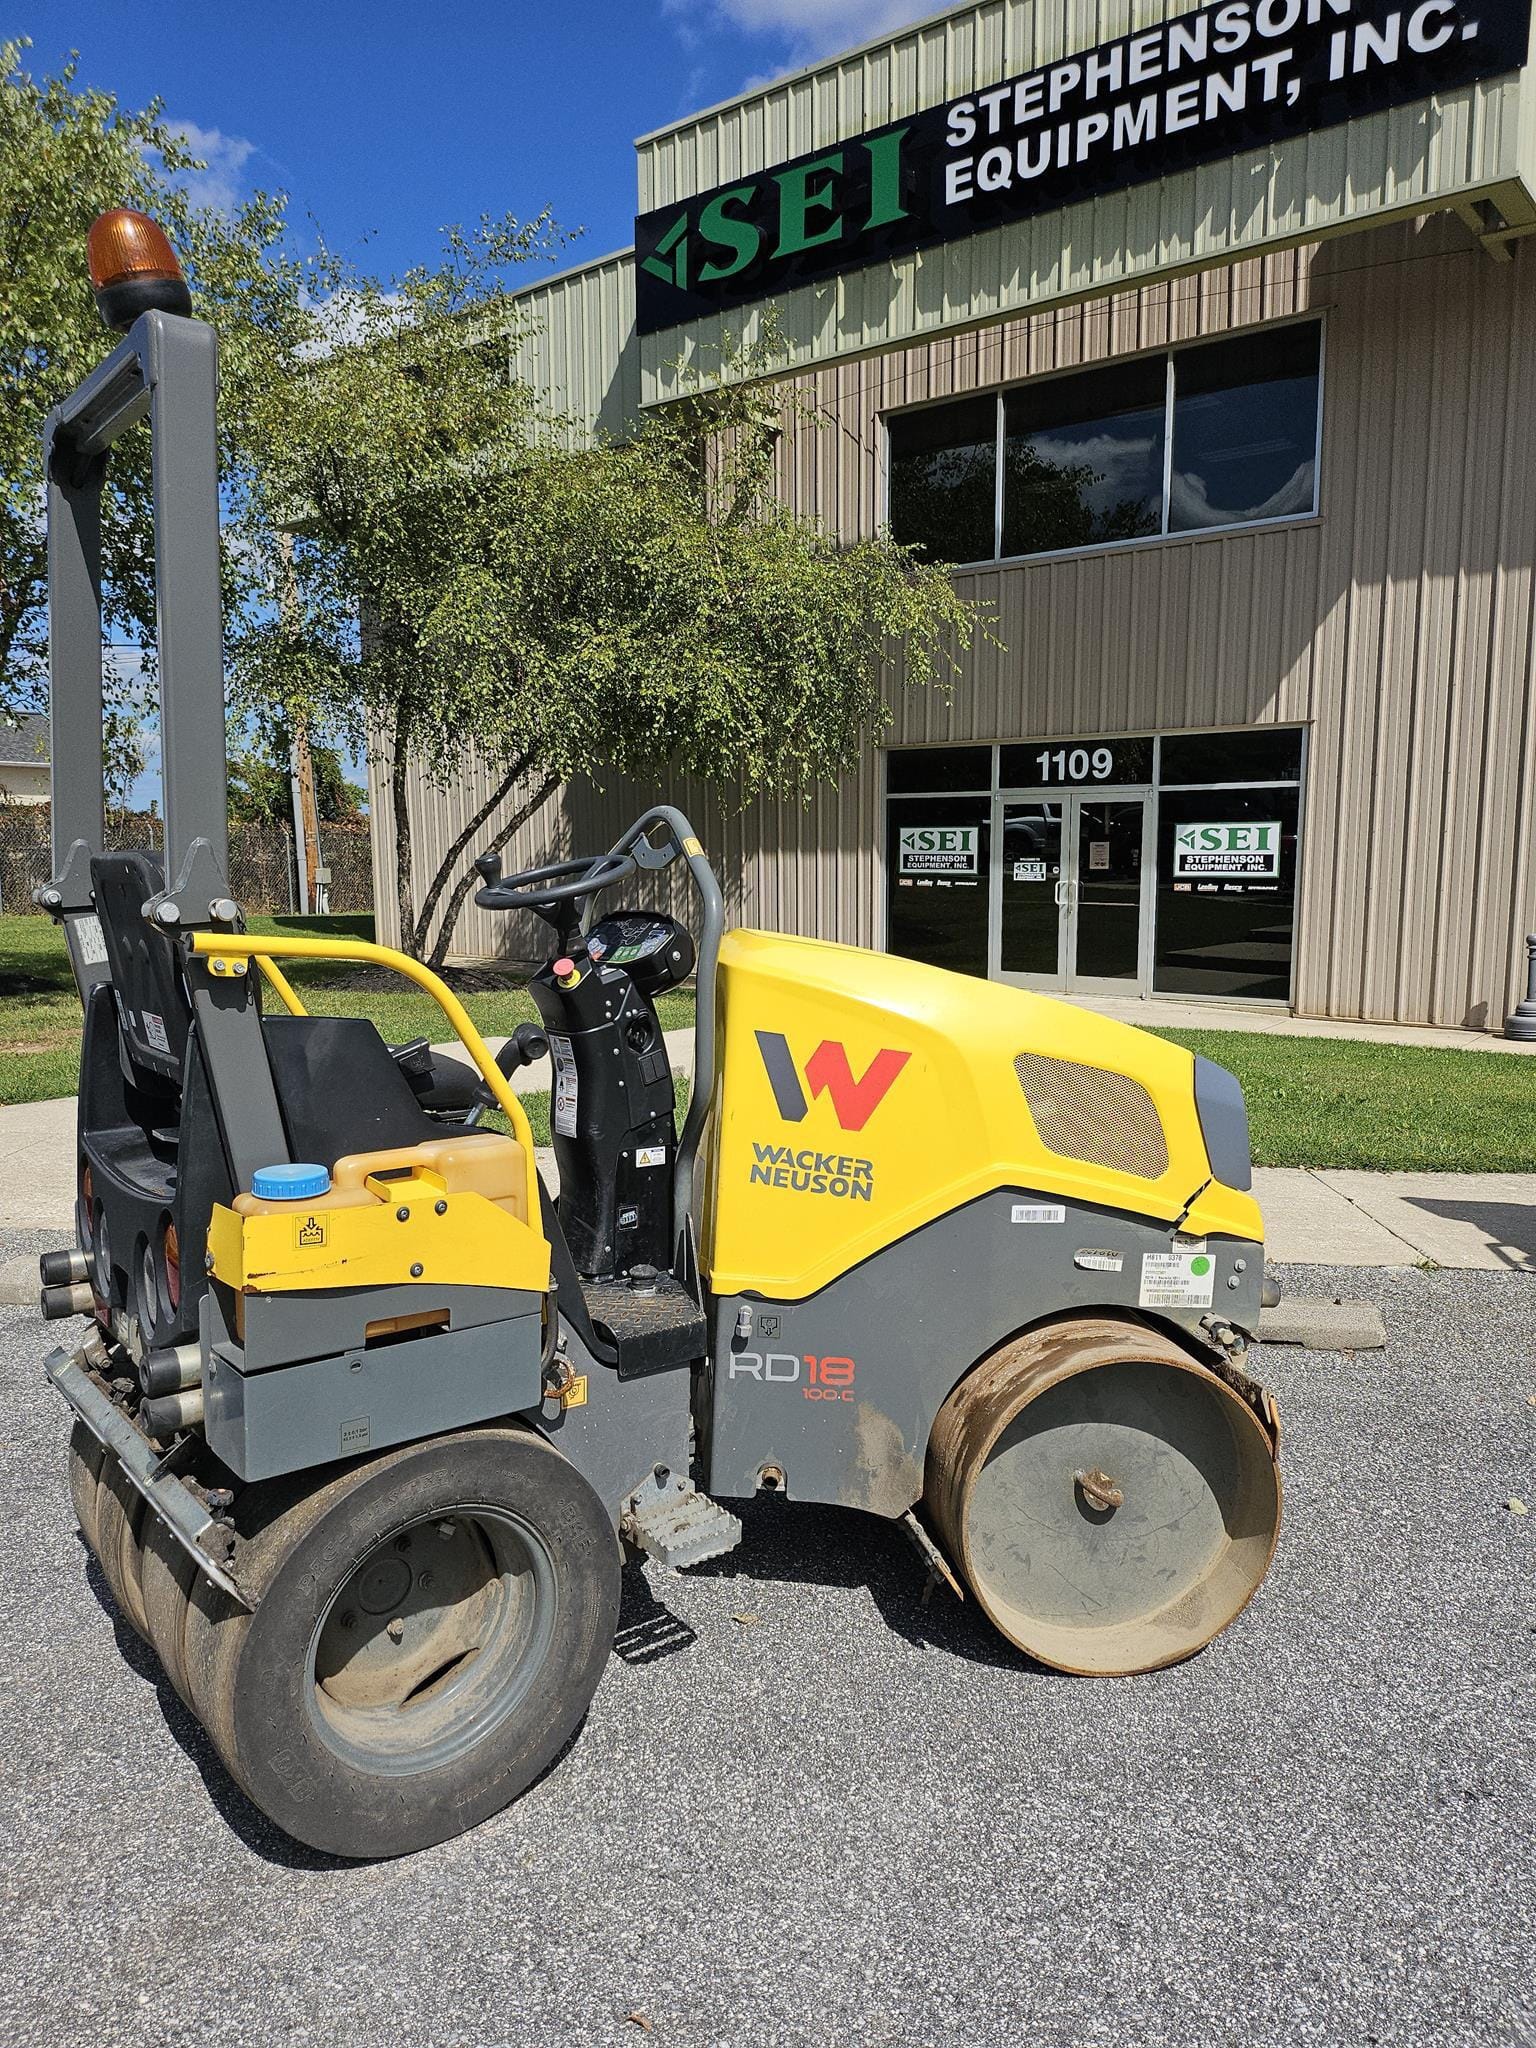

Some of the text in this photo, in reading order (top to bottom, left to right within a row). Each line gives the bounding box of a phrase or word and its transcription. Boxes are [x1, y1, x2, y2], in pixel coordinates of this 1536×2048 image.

[945, 0, 1479, 206] EQUIPMENT, INC.
[698, 127, 911, 282] SEI
[1036, 748, 1113, 781] 1109
[918, 830, 973, 852] SEI
[1199, 827, 1272, 851] SEI
[908, 855, 967, 863] STEPHENSON
[1021, 863, 1044, 873] SEI
[1184, 863, 1268, 871] EQUIPMENT, INC.
[1186, 855, 1264, 864] STEPHENSON
[752, 1142, 874, 1181] WACKER
[749, 1164, 873, 1202] NEUSON
